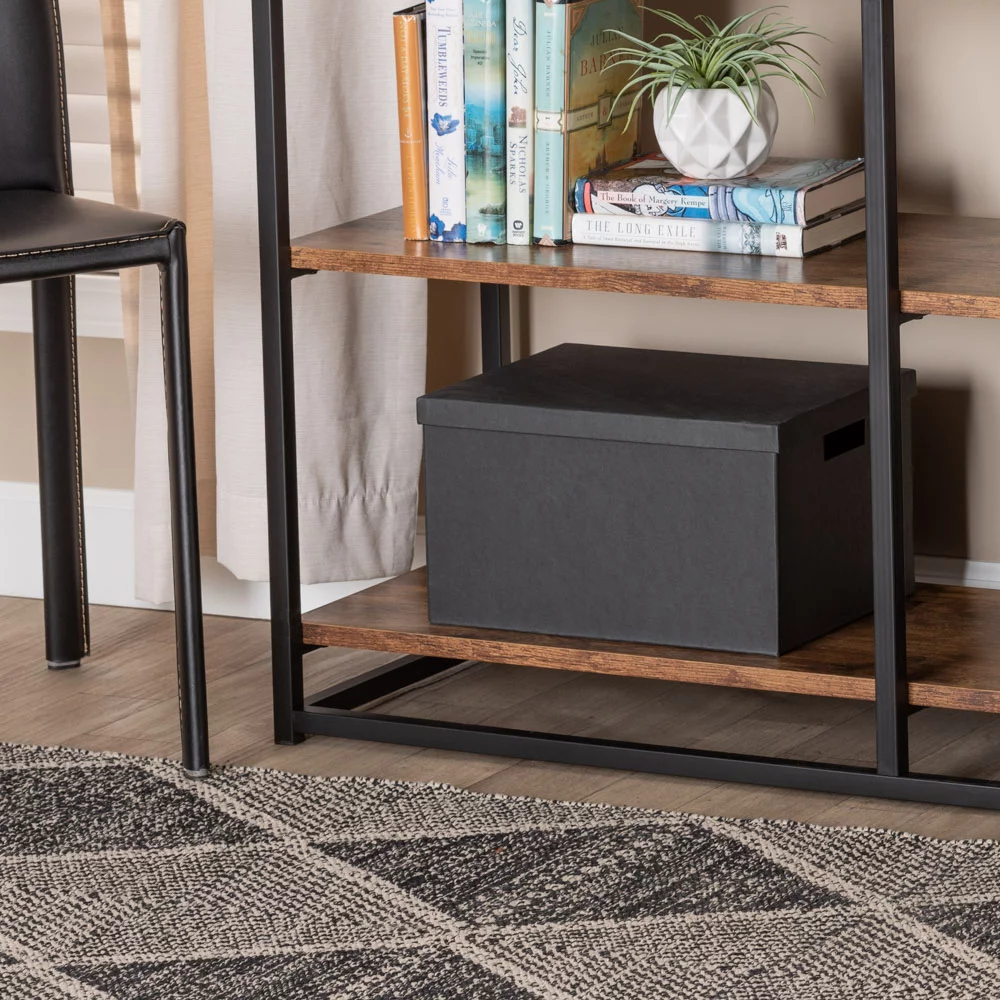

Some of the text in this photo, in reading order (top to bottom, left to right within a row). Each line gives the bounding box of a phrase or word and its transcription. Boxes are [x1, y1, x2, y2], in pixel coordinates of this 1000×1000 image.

[437, 26, 451, 107] TUMBLEWEEDS
[508, 17, 528, 95] Dear John
[509, 141, 518, 185] SPARKS
[519, 135, 528, 194] NICHOLAS
[600, 192, 615, 200] The
[618, 193, 636, 202] Book
[648, 195, 678, 206] Margery
[680, 197, 706, 207] Kempe
[586, 219, 697, 239] THE LONG EXILE
